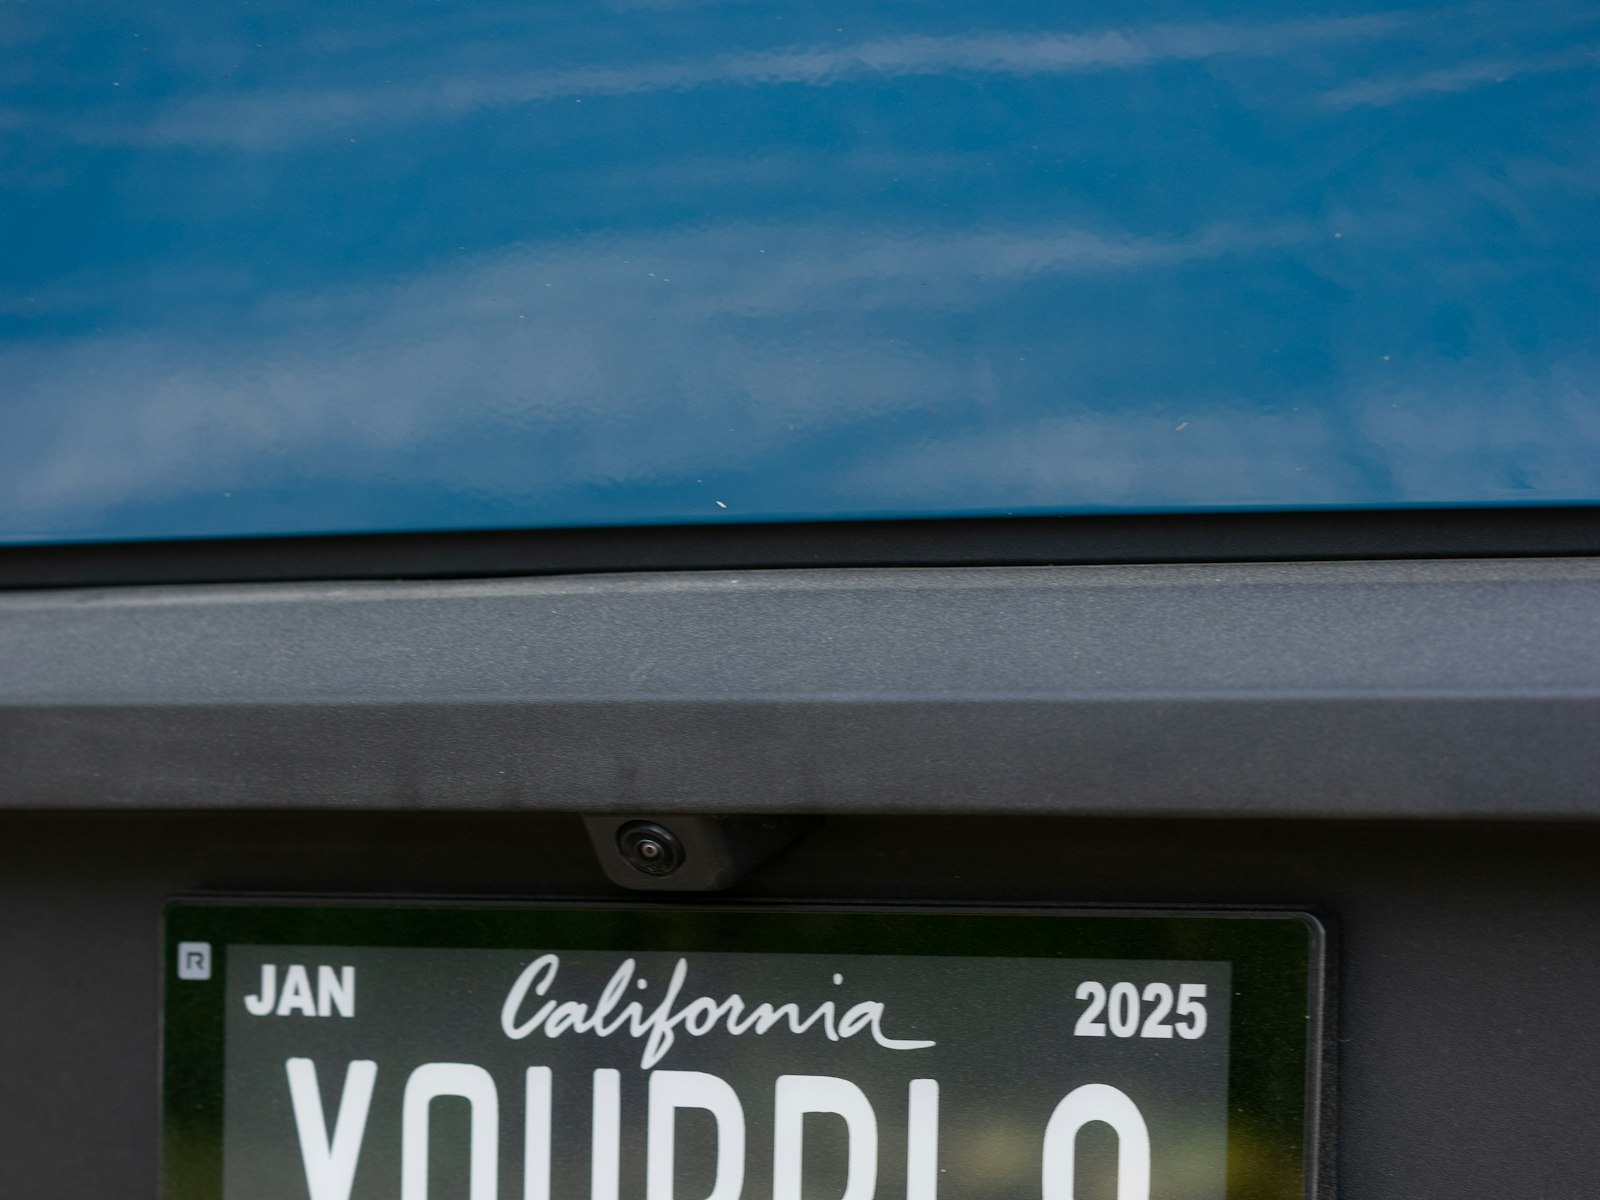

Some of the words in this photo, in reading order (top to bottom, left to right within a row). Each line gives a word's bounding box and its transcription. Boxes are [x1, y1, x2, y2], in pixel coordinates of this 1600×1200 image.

[243, 964, 356, 1019] JAN
[501, 953, 937, 1071] California
[1073, 980, 1208, 1041] 2025
